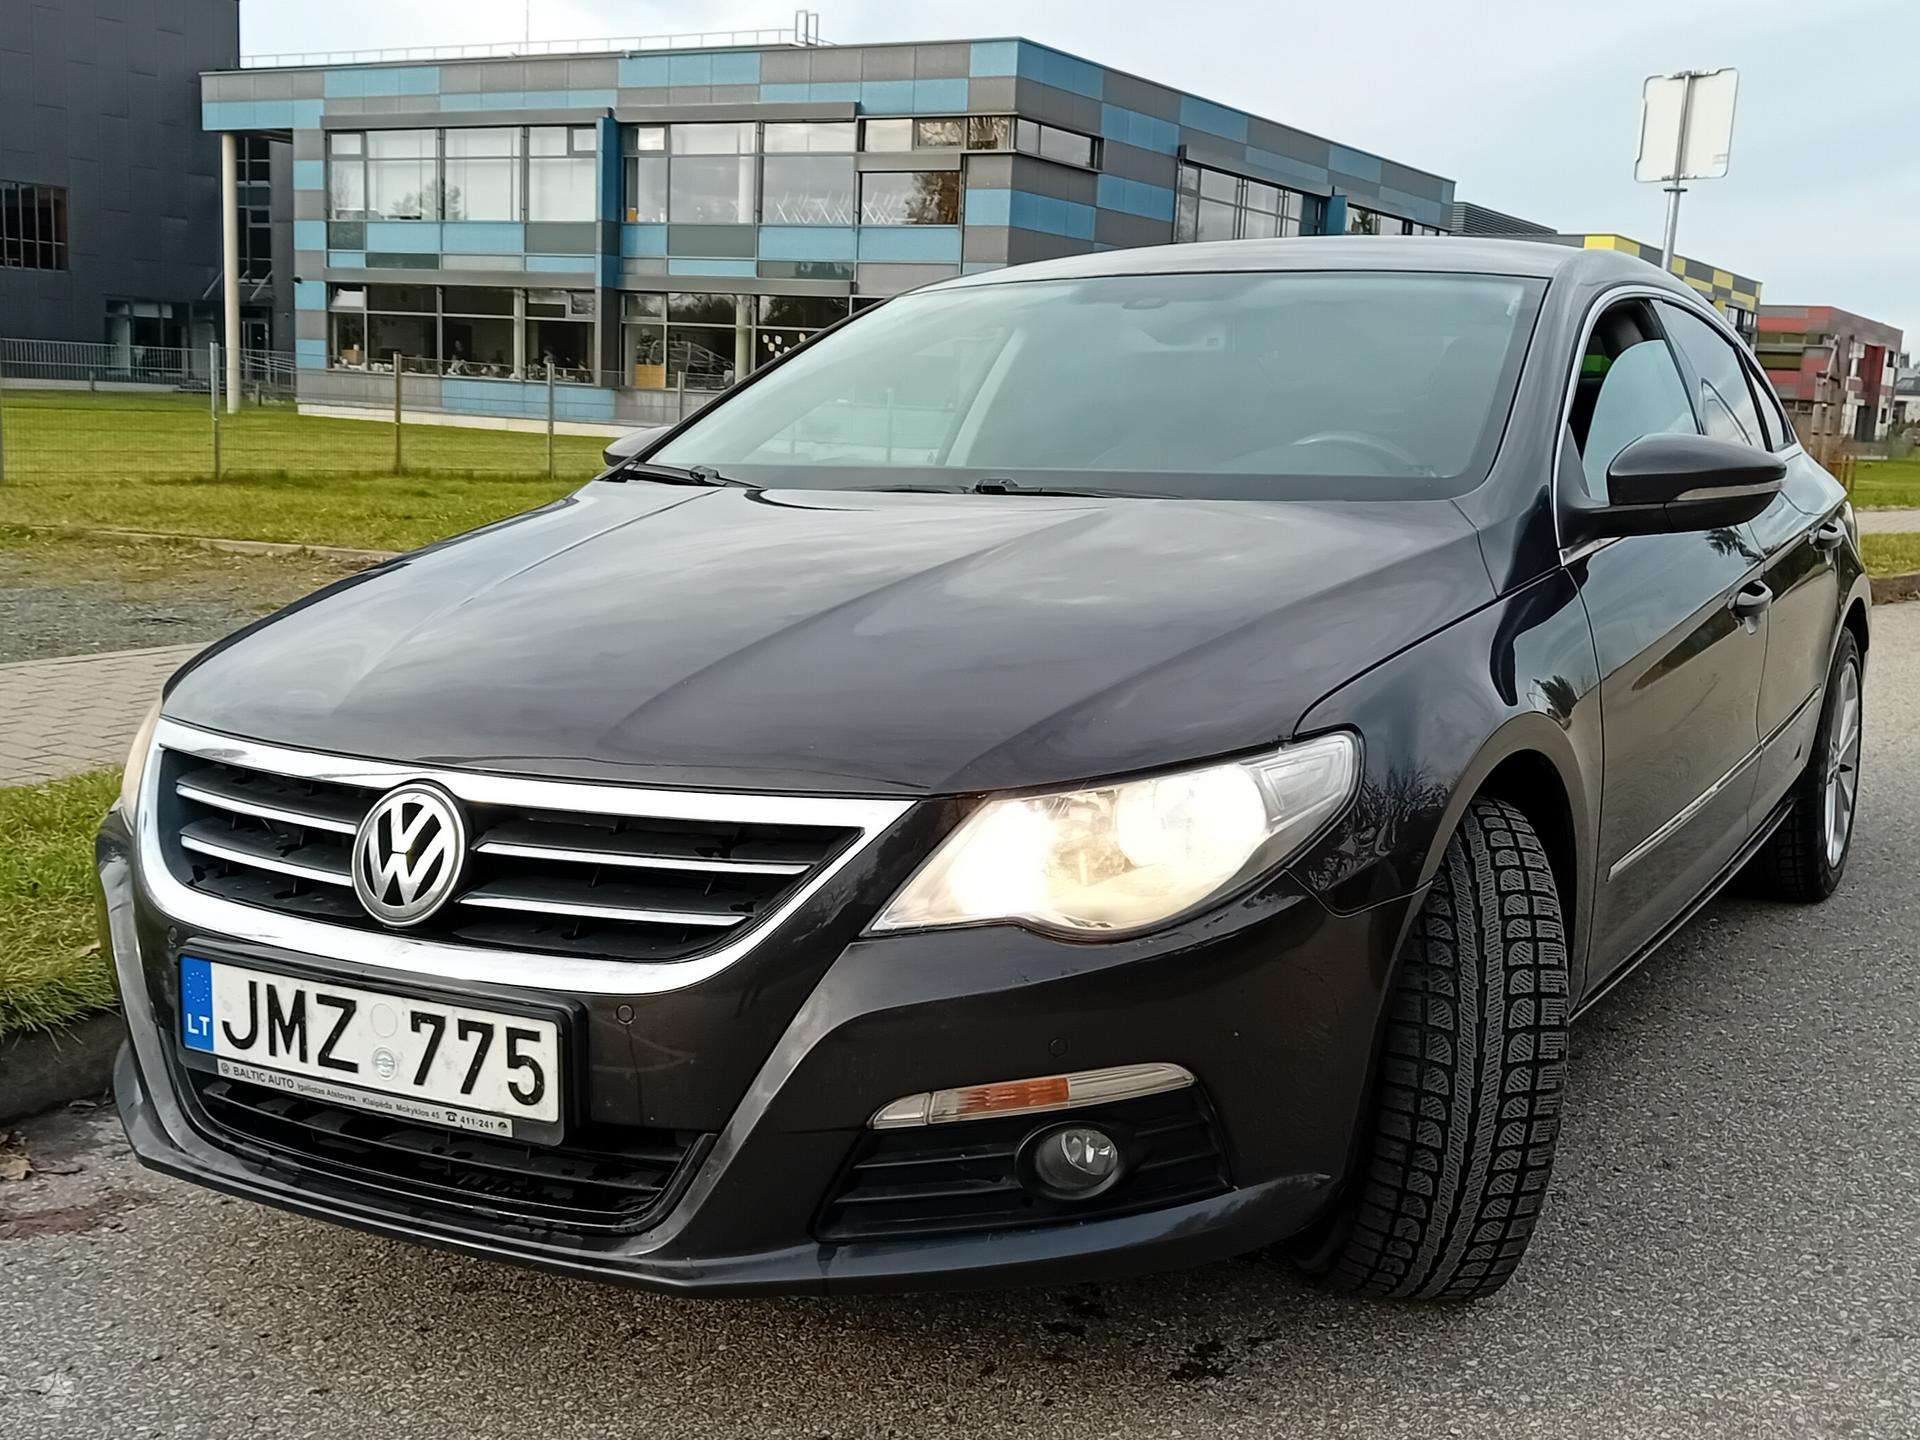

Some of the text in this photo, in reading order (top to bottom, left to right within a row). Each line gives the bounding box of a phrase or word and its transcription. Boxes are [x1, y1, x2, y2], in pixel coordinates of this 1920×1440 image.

[361, 791, 455, 915] VW
[187, 1013, 211, 1037] LT
[221, 980, 545, 1106] JMZ 775
[233, 1066, 266, 1083] BALTIC
[268, 1074, 294, 1089] AUTO
[461, 1116, 494, 1129] 411-241
